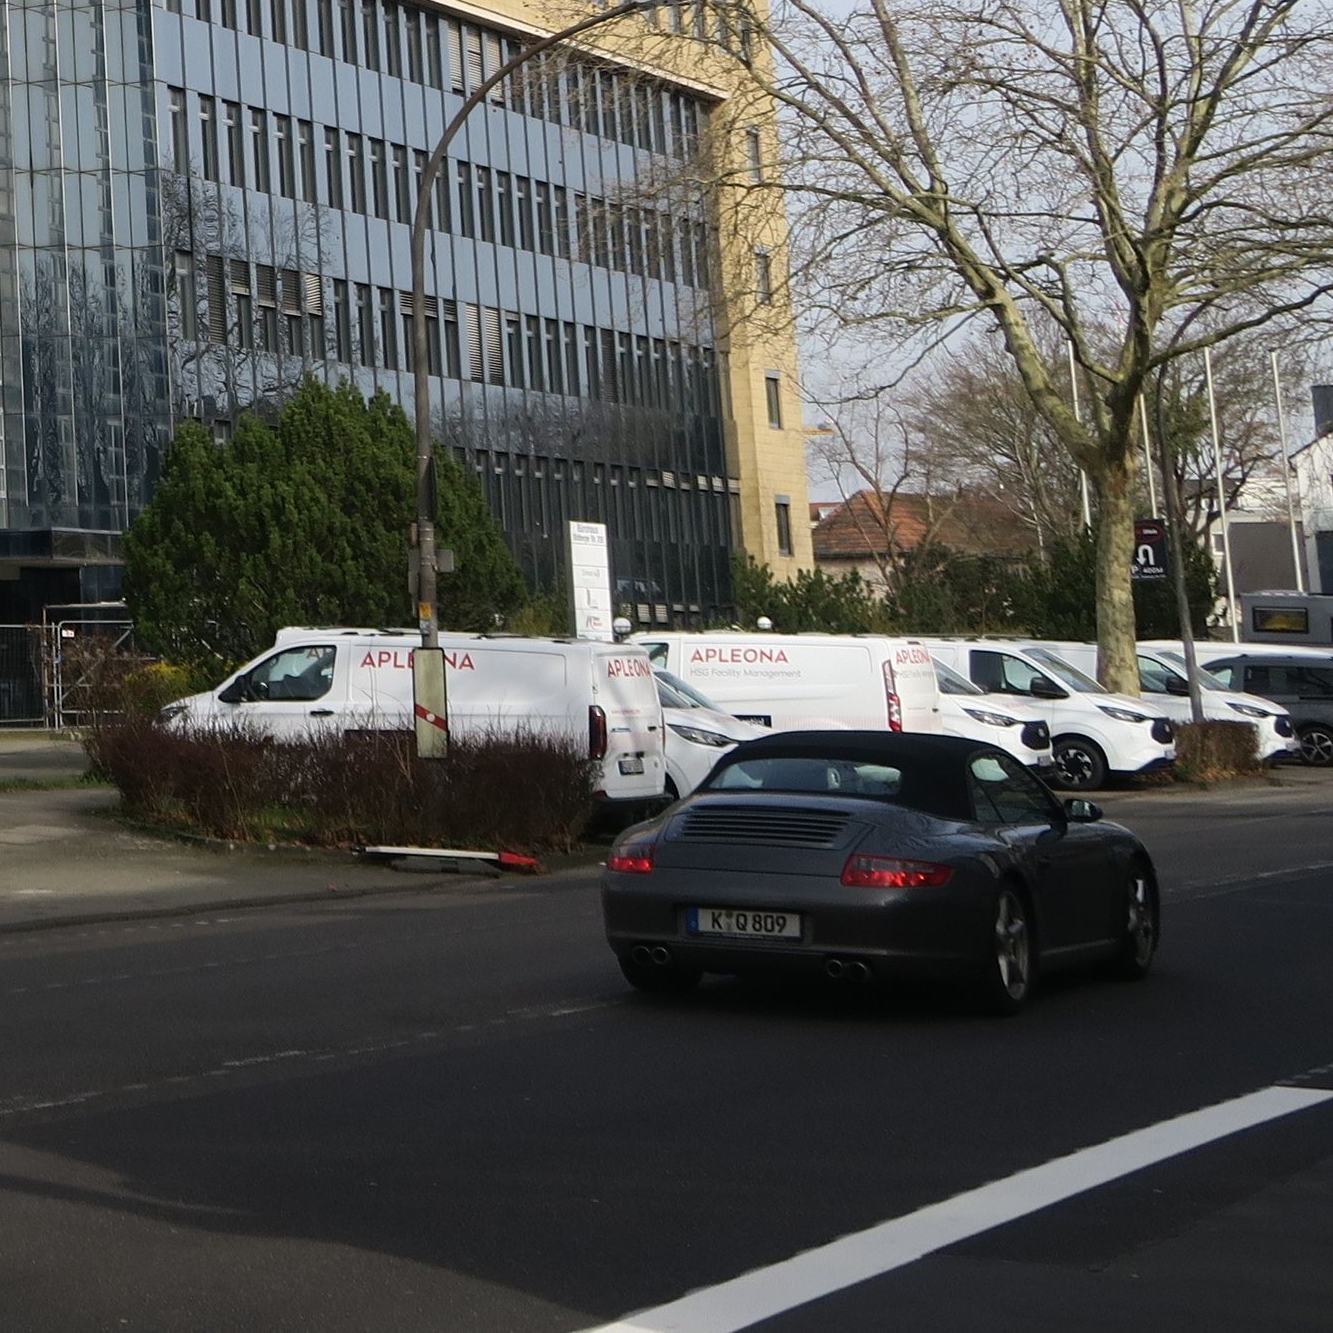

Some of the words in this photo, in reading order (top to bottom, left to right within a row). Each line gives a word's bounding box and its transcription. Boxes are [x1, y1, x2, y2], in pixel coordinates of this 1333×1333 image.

[361, 651, 475, 670] APLENA
[691, 649, 789, 663] APLEONA
[712, 668, 741, 679] Facility
[743, 668, 801, 679] Management
[711, 911, 722, 930] K
[736, 913, 748, 931] Q
[752, 914, 786, 933] 809
